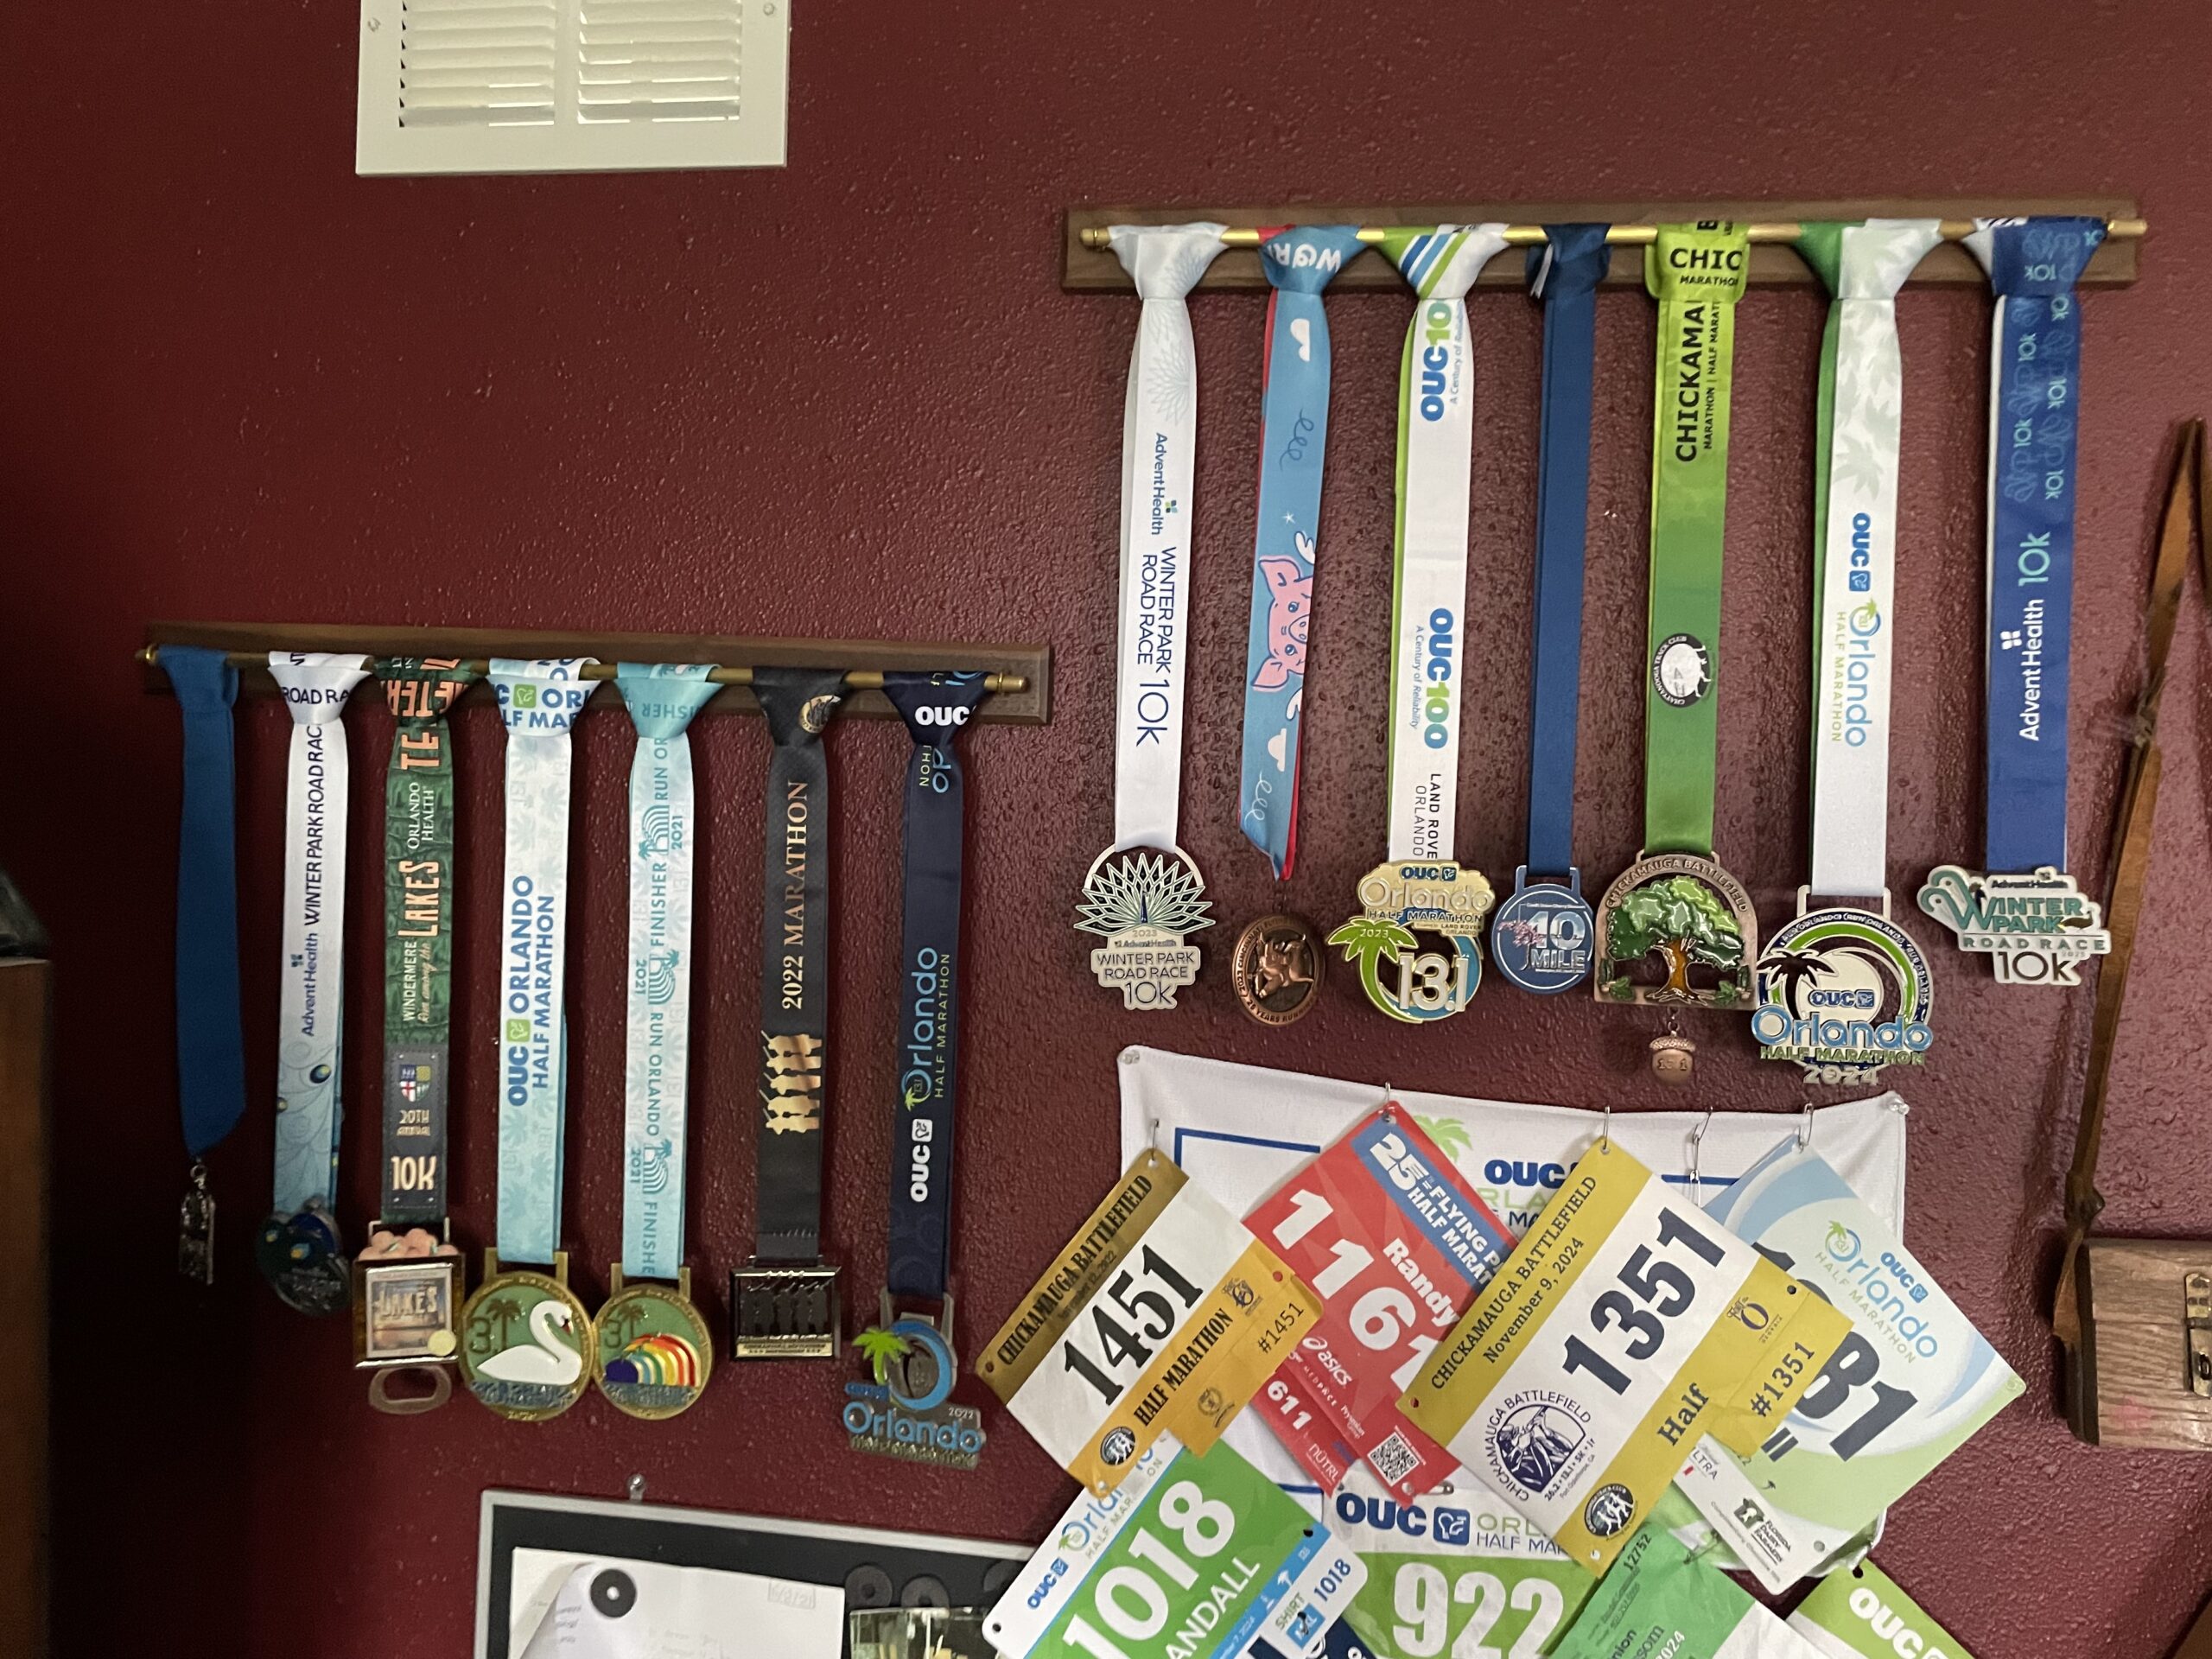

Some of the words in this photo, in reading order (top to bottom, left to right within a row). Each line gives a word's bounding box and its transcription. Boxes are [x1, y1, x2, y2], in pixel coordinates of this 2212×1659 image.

[1675, 300, 1706, 462] CHICKAMA
[1151, 432, 1168, 536] AdventHealth
[1850, 512, 1872, 568] OUC
[1140, 554, 1158, 611] ROAD
[1158, 546, 1177, 620] WINTER
[1137, 613, 1155, 665] RACE
[1155, 624, 1174, 674] PARK
[1412, 635, 1424, 671] Century
[1835, 611, 1847, 652] HALF
[1845, 600, 1881, 747] Orlando
[2019, 599, 2044, 741] AdventHealth
[914, 705, 970, 726] OUC
[1409, 685, 1422, 730] Reliability
[1831, 657, 1845, 742] MARATHON
[308, 766, 324, 816] ROAD
[654, 766, 668, 801] RUN
[1428, 773, 1441, 813] LAND
[307, 817, 324, 860] PARK
[406, 782, 421, 849] ORLANDO
[421, 788, 435, 842] HEALTH
[671, 815, 683, 849] 2021
[1413, 785, 1427, 856] ORLANDO
[784, 781, 809, 947] MARATHON
[1401, 866, 1440, 880] OUC
[1606, 858, 1681, 908] CHICKAMAUGA
[1684, 859, 1748, 913] BATTLEFIELD
[304, 860, 323, 926] WINTER
[397, 861, 440, 937] LAKES
[651, 861, 667, 947] FINISHER
[1361, 877, 1496, 911] Orlando
[1368, 910, 1402, 919] HALF
[1408, 910, 1483, 923] MARATHON
[509, 874, 533, 1014] ORLANDO
[1360, 928, 1389, 938] 2023
[1963, 937, 2030, 949] ROAD
[2040, 938, 2107, 950] RACE
[1993, 915, 2068, 934] PARK
[302, 932, 319, 1037] AdventHealth
[402, 940, 417, 1022] WINDERMERE
[533, 895, 555, 1028] MARATHON
[635, 959, 646, 995] 2021
[781, 955, 804, 1010] 2022
[1097, 952, 1154, 966] WINTER
[1157, 952, 1195, 963] PARK
[1104, 968, 1147, 980] ROAD
[1149, 967, 1188, 979] RACE
[1530, 949, 1586, 969] MILE
[937, 953, 950, 1048] MARATHON
[1811, 990, 1855, 1007] OUC
[649, 1012, 664, 1046] RUN
[901, 946, 938, 1110] Orlando
[1751, 1005, 1934, 1052] Orlando
[507, 1046, 529, 1107] OUC
[532, 1033, 550, 1089] HALF
[935, 1055, 946, 1098] HALF
[1760, 1046, 1810, 1060] HALF
[1815, 1046, 1925, 1065] MARATHON
[1803, 1065, 1879, 1086] 2024
[645, 1053, 663, 1137] ORLANDO
[910, 1144, 931, 1203] OUC
[1408, 1187, 1448, 1229] HALF
[1428, 1185, 1488, 1252] FLYING
[996, 1266, 1080, 1365] CHICKAMAUGA
[1071, 1174, 1154, 1273] BATTLEFIELD
[1382, 1237, 1460, 1327] Randy
[1430, 1279, 1522, 1391] CHICKAMAUGA
[1516, 1175, 1597, 1281] BATTLEFIELD
[1825, 1221, 1938, 1358] Orlando
[1880, 1251, 1915, 1288] OUC
[1064, 1243, 1204, 1407] 1451
[1483, 1289, 1544, 1363] November
[1540, 1276, 1560, 1292] 9,
[1552, 1236, 1586, 1275] 2024
[1561, 1206, 1726, 1396] 1351
[1815, 1251, 1849, 1287] HALF
[1849, 1288, 1916, 1363] MARATHON
[1257, 1301, 1306, 1355] #1451
[1133, 1385, 1170, 1427] HALF
[1165, 1307, 1235, 1392] MARATHON
[1317, 1351, 1352, 1387] asics
[1750, 1341, 1815, 1418] #1351
[842, 1401, 982, 1453] Orlando
[948, 1407, 976, 1420] 2022
[1267, 1380, 1313, 1431] 611
[1503, 1389, 1592, 1424] BATTLEFIELD
[1656, 1382, 1711, 1447] Half
[1484, 1407, 1529, 1502] CHICKAMAUGA
[1692, 1446, 1719, 1480] LTRA
[1336, 1491, 1427, 1536] OUC
[1085, 1527, 1109, 1560] HALF
[1476, 1532, 1521, 1551] HALF
[1624, 1534, 1653, 1572] 12752
[1027, 1573, 1058, 1609] OUC
[1062, 1480, 1236, 1659] 1018
[1314, 1558, 1351, 1602] 1018
[1275, 1592, 1306, 1631] SHIRT
[1392, 1561, 1564, 1659] 922
[1848, 1586, 1923, 1659] OUC
